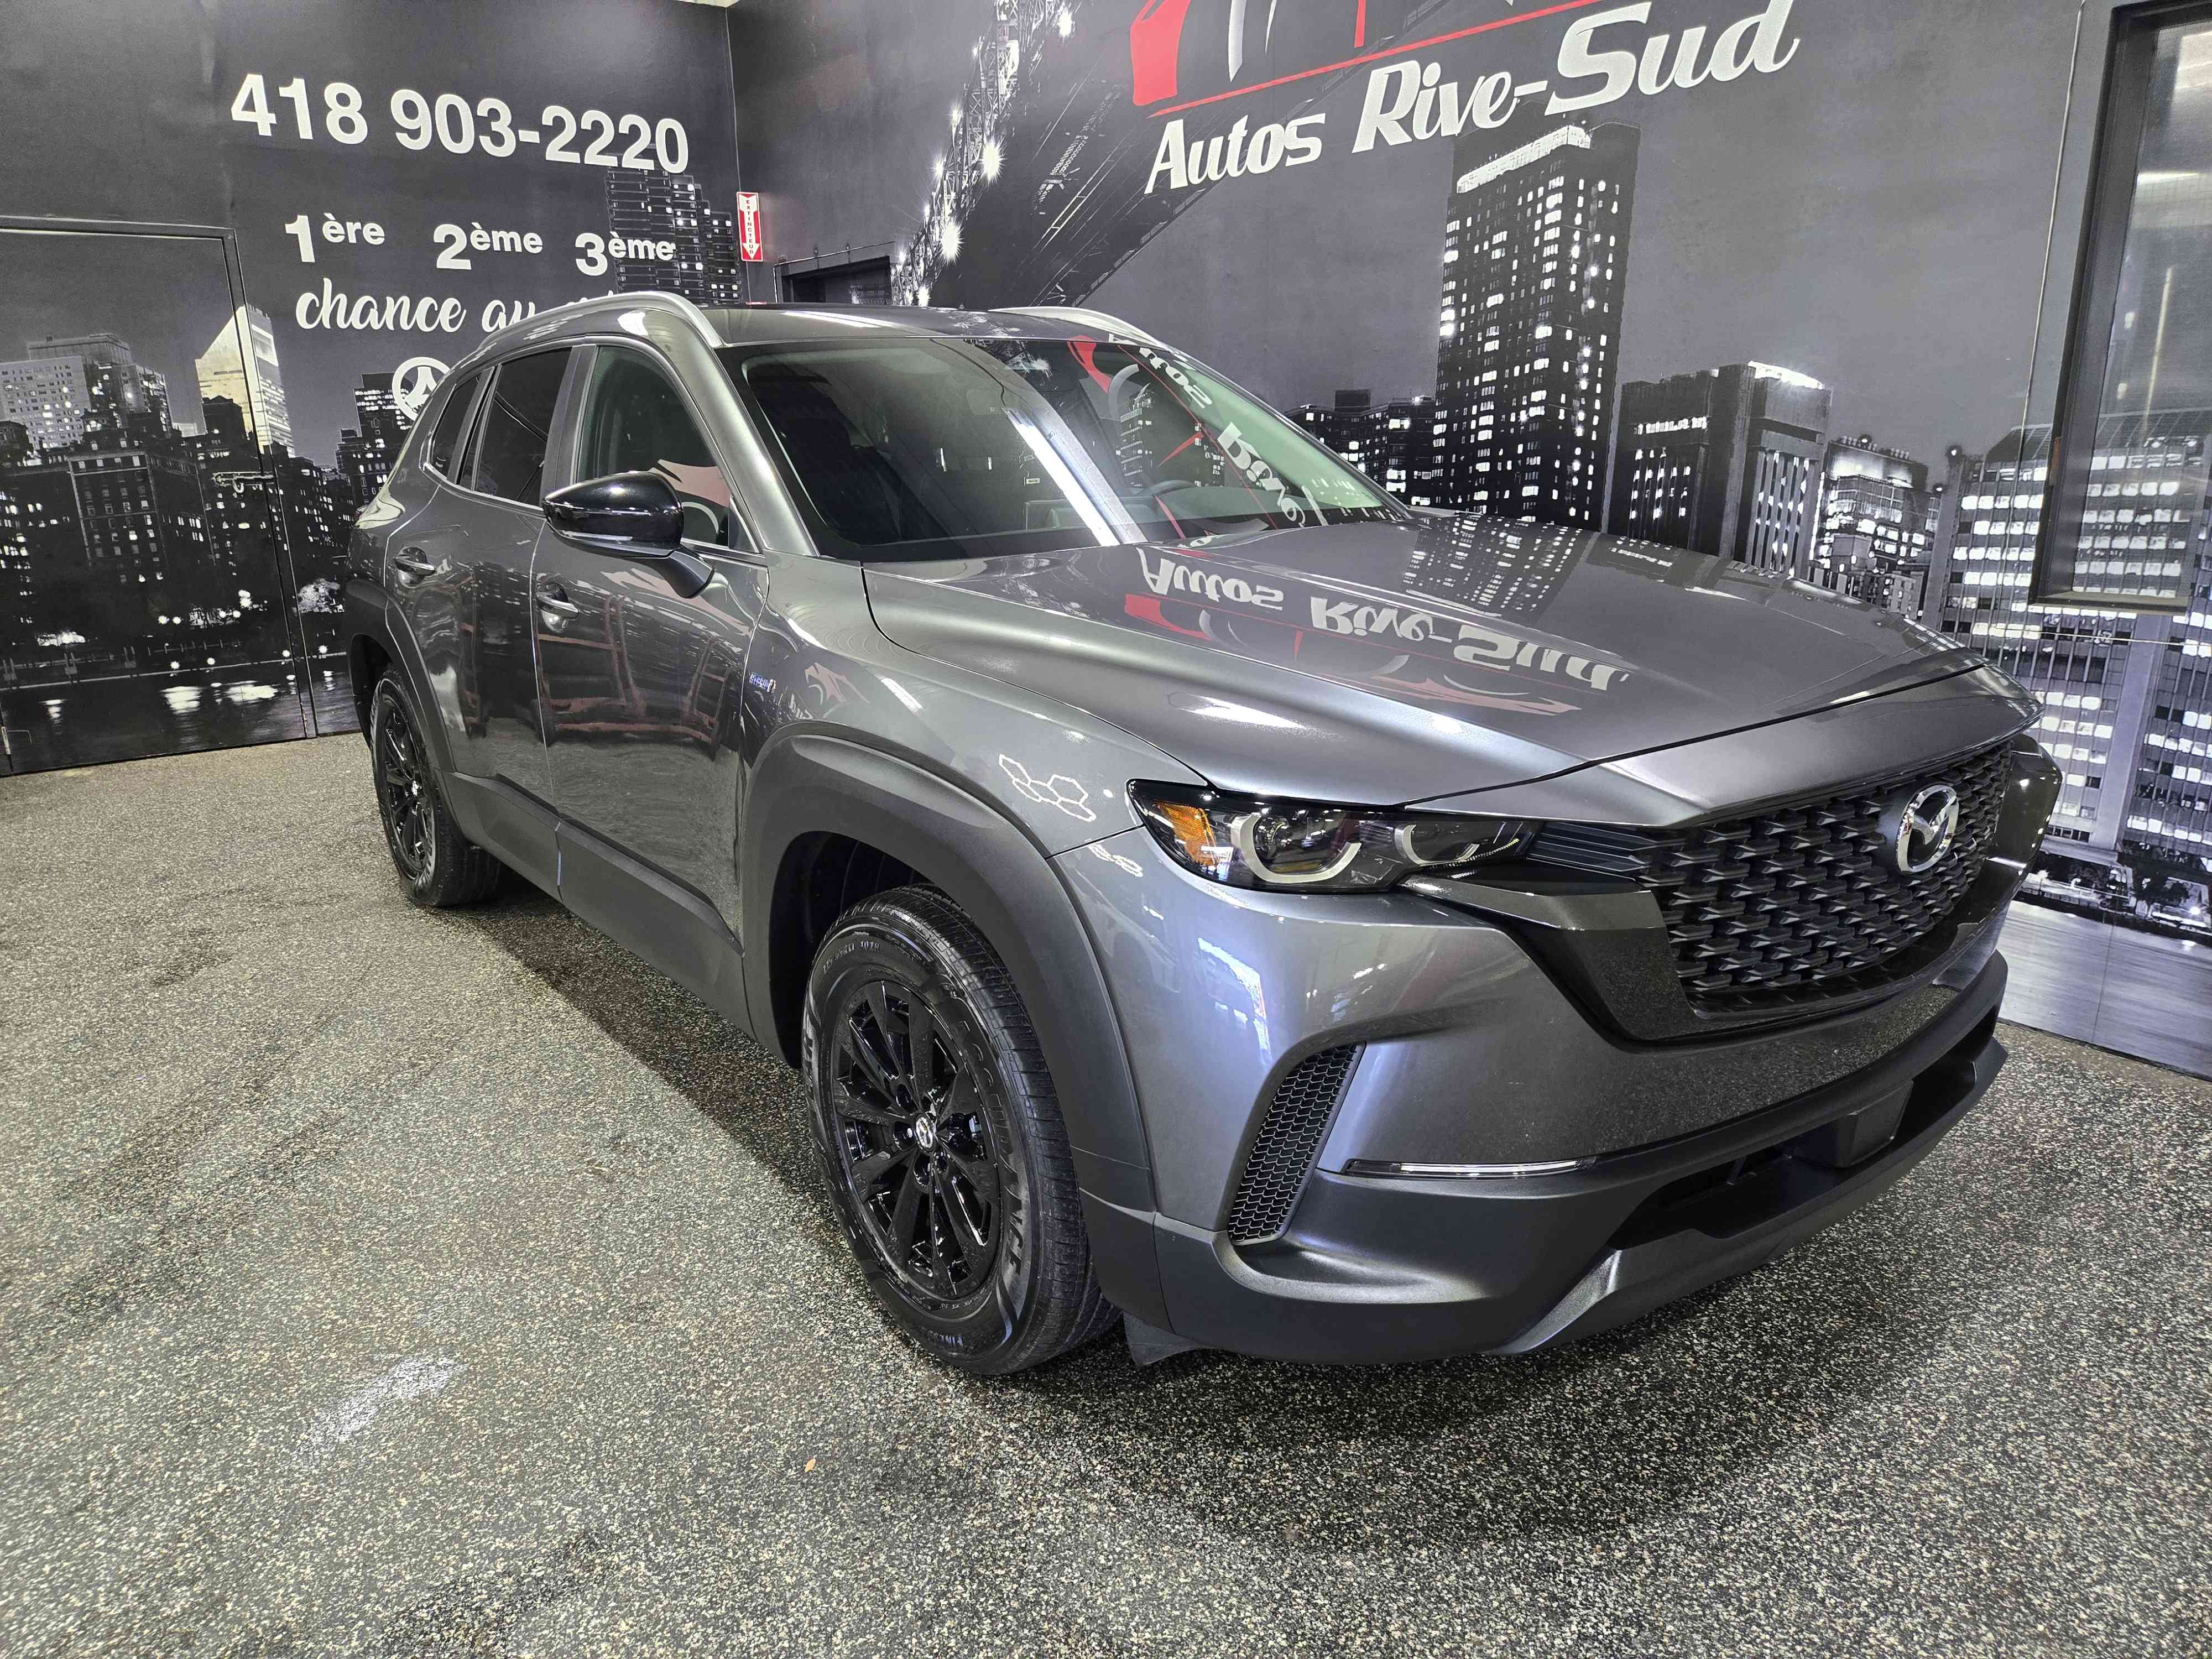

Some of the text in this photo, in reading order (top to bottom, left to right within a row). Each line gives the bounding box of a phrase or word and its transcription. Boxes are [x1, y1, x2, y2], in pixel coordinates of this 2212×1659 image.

[231, 74, 688, 174] 418 903-2220
[1144, 0, 1801, 195] Autos Rive-Sud
[285, 212, 677, 276] 1ère 2ème 3ème
[295, 278, 467, 332] chance
